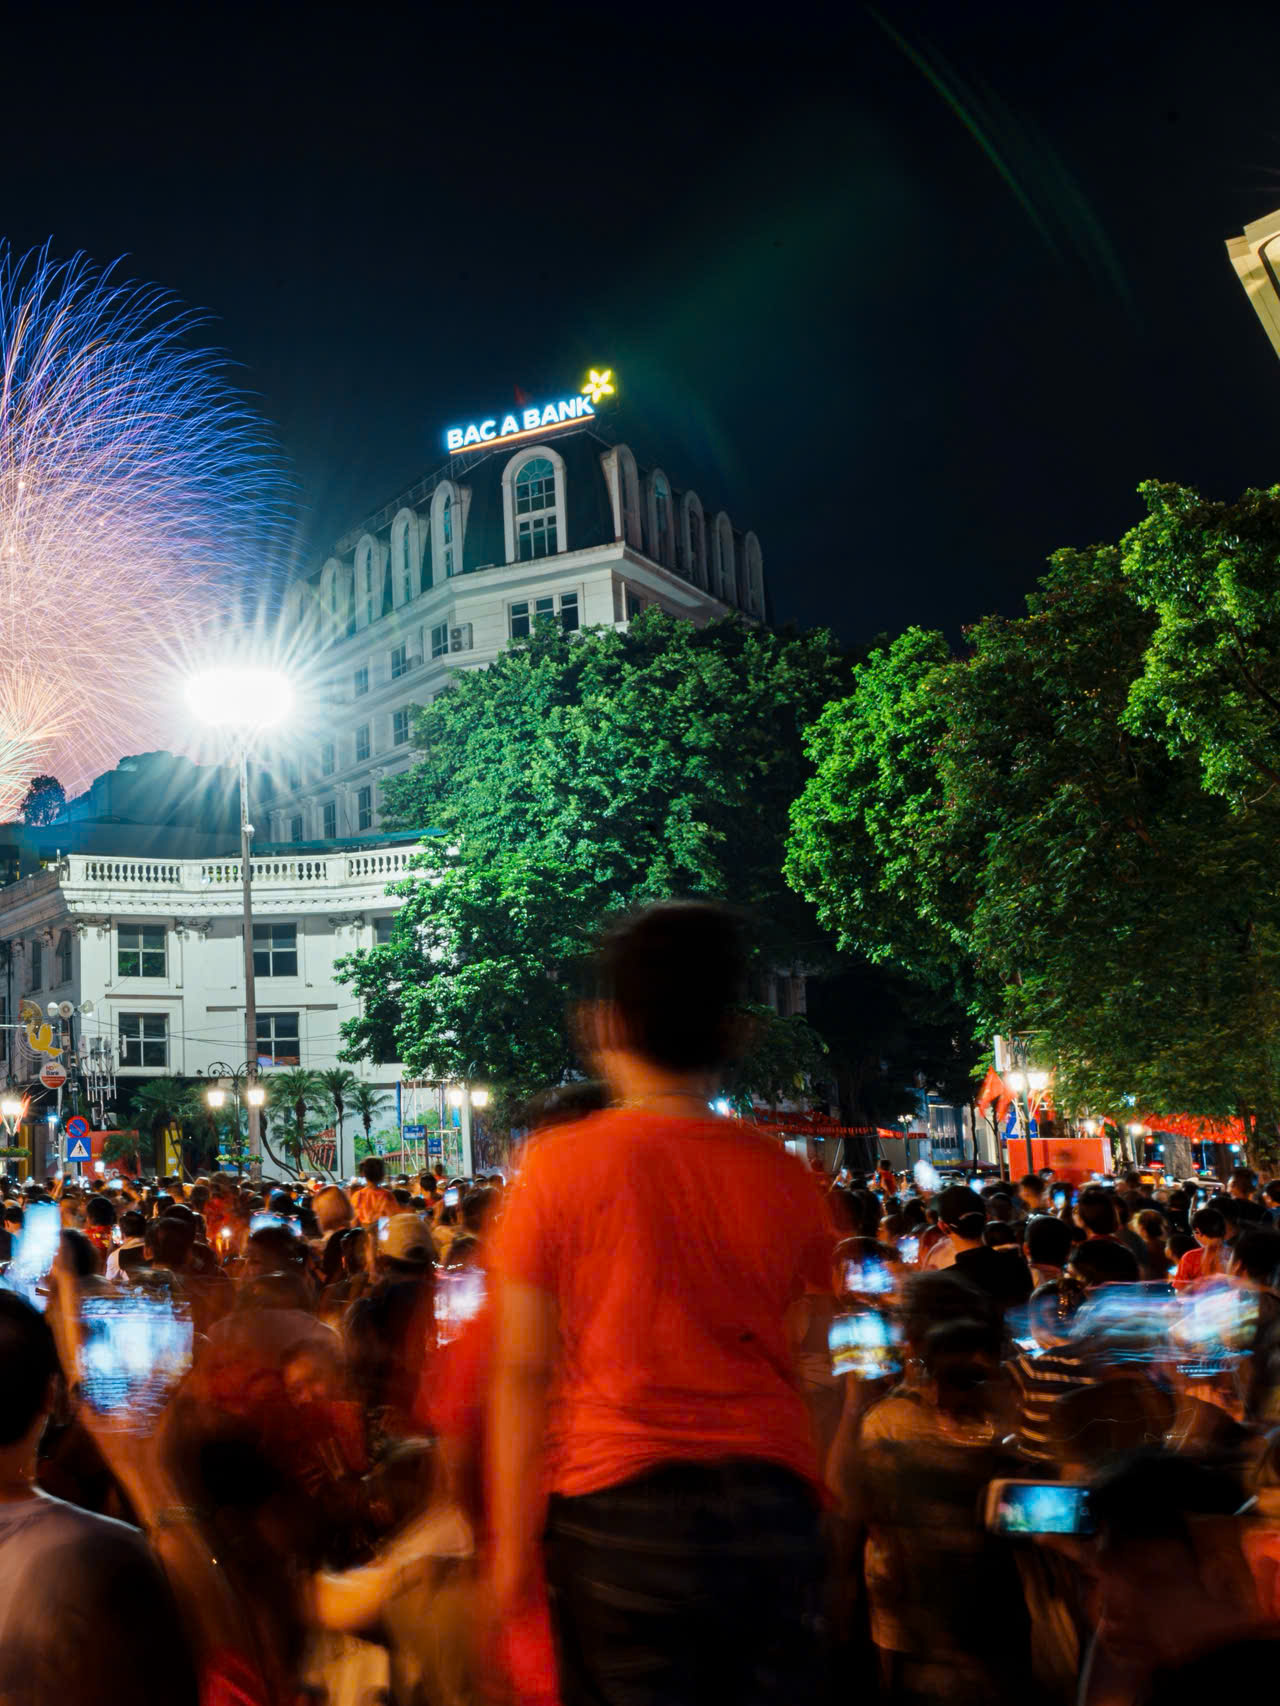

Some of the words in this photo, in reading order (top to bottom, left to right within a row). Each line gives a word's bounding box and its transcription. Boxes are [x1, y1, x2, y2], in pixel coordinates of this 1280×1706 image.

[447, 420, 496, 450] BAC
[501, 415, 519, 436] A
[523, 395, 595, 430] BANK
